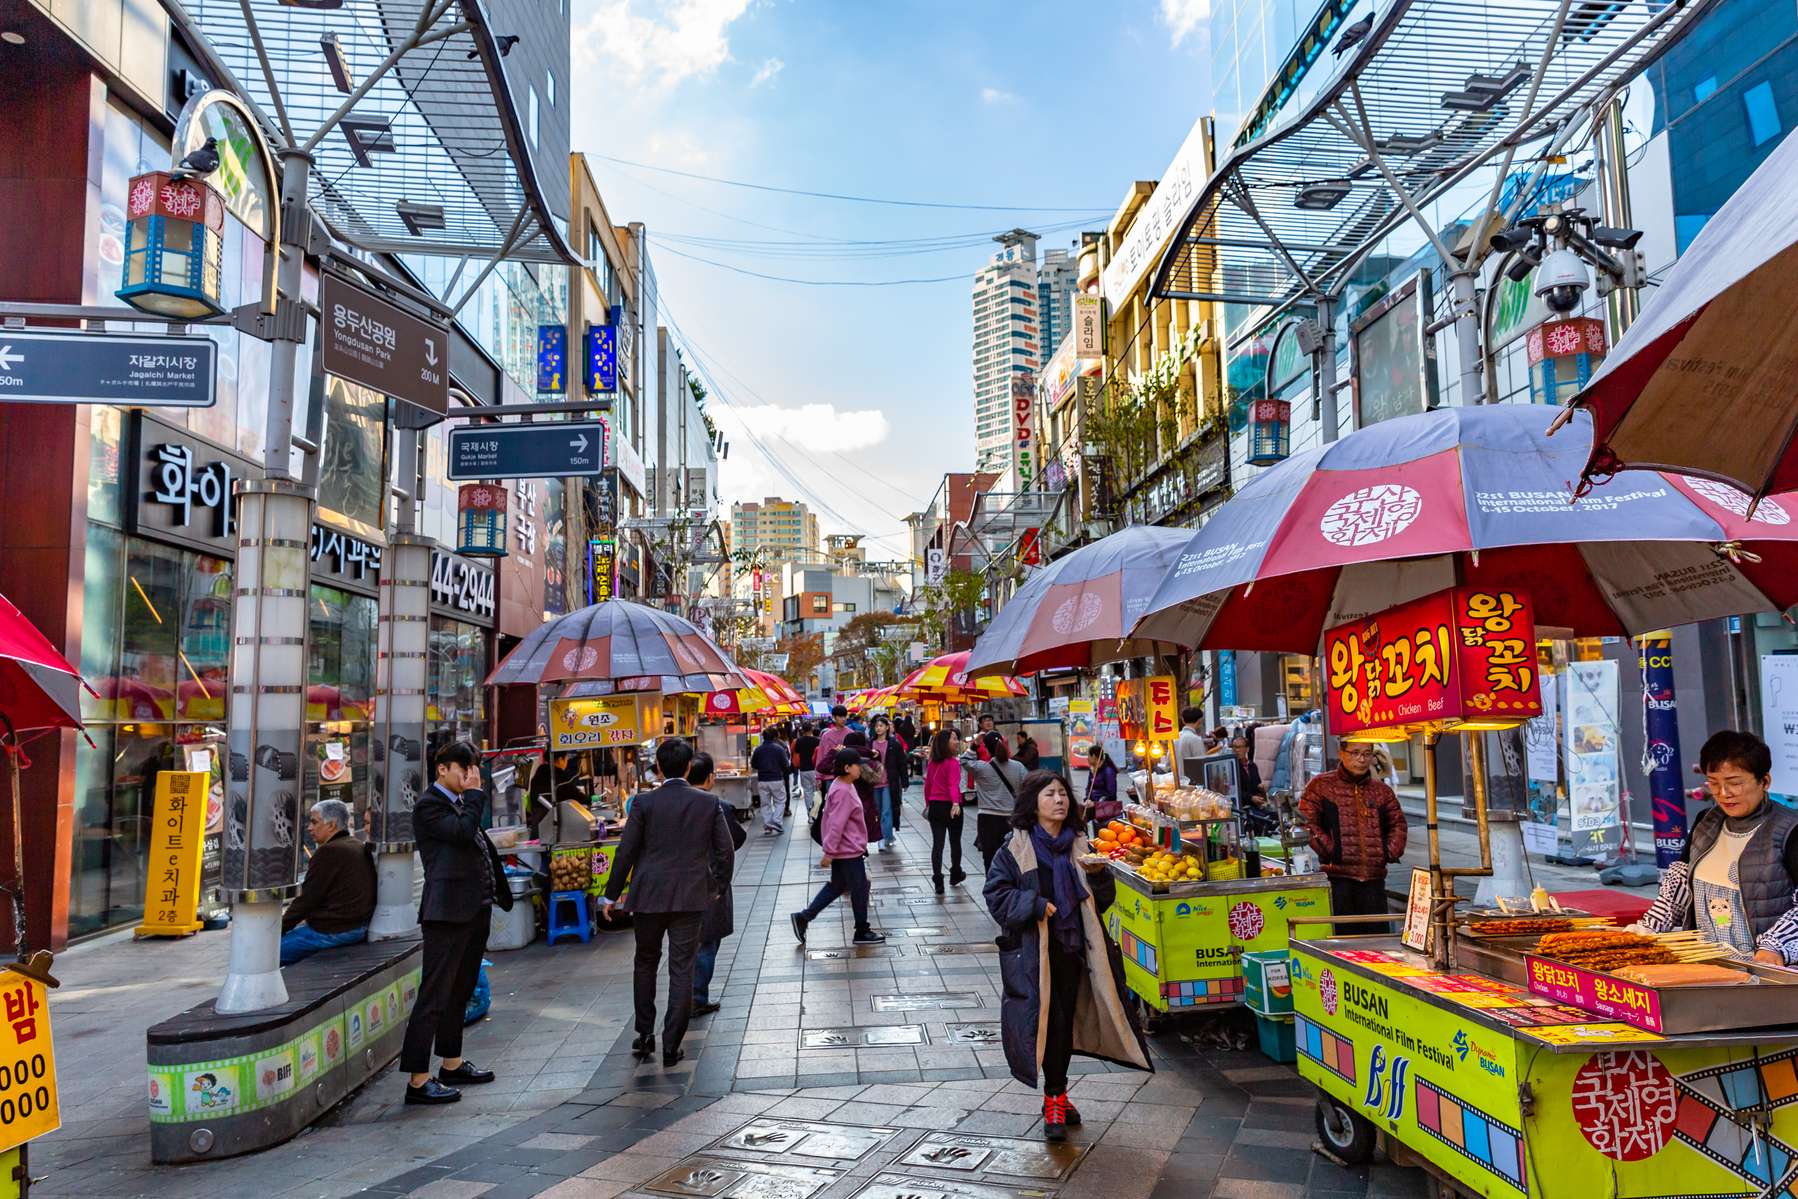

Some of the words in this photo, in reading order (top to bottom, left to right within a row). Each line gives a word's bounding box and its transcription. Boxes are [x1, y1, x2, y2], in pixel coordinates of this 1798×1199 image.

[333, 304, 396, 351] 용두산공원
[1083, 315, 1094, 349] 슬라임
[334, 328, 374, 353] Yongdusan
[376, 346, 392, 361] Park
[129, 355, 197, 370] 자갈치시장
[129, 371, 164, 379] Jagalchi
[167, 372, 195, 380] Market
[1016, 398, 1031, 440] DVD
[461, 441, 498, 452] 국제시장
[570, 457, 589, 465] 150m
[156, 445, 235, 538] 화이
[1477, 499, 1567, 507] International
[1606, 488, 1668, 504] Festival
[1508, 490, 1571, 499] BUSAN
[1584, 502, 1617, 511] 2017
[432, 553, 496, 617] 44-2944
[1398, 704, 1422, 716] Chicken
[1428, 697, 1444, 712] Beef
[588, 714, 611, 726] 원조
[560, 731, 601, 745] 회오리
[608, 728, 634, 743] 감자
[160, 796, 188, 907] 화이트e치과
[1656, 838, 1687, 848] BUSA
[158, 909, 178, 923] 2층
[1196, 959, 1242, 968] Internation
[1532, 961, 1580, 993] 왕닭꼬치
[1594, 978, 1651, 1015] 왕소세지
[1343, 981, 1389, 1020] BUSAN
[3, 980, 39, 1045] 밤
[1344, 1005, 1394, 1041] International
[1395, 1028, 1415, 1052] Film
[1417, 1038, 1455, 1072] Festival
[1470, 1040, 1497, 1061] Dynamic
[277, 1062, 292, 1082] BIFF
[1480, 1056, 1505, 1078] BUSAN
